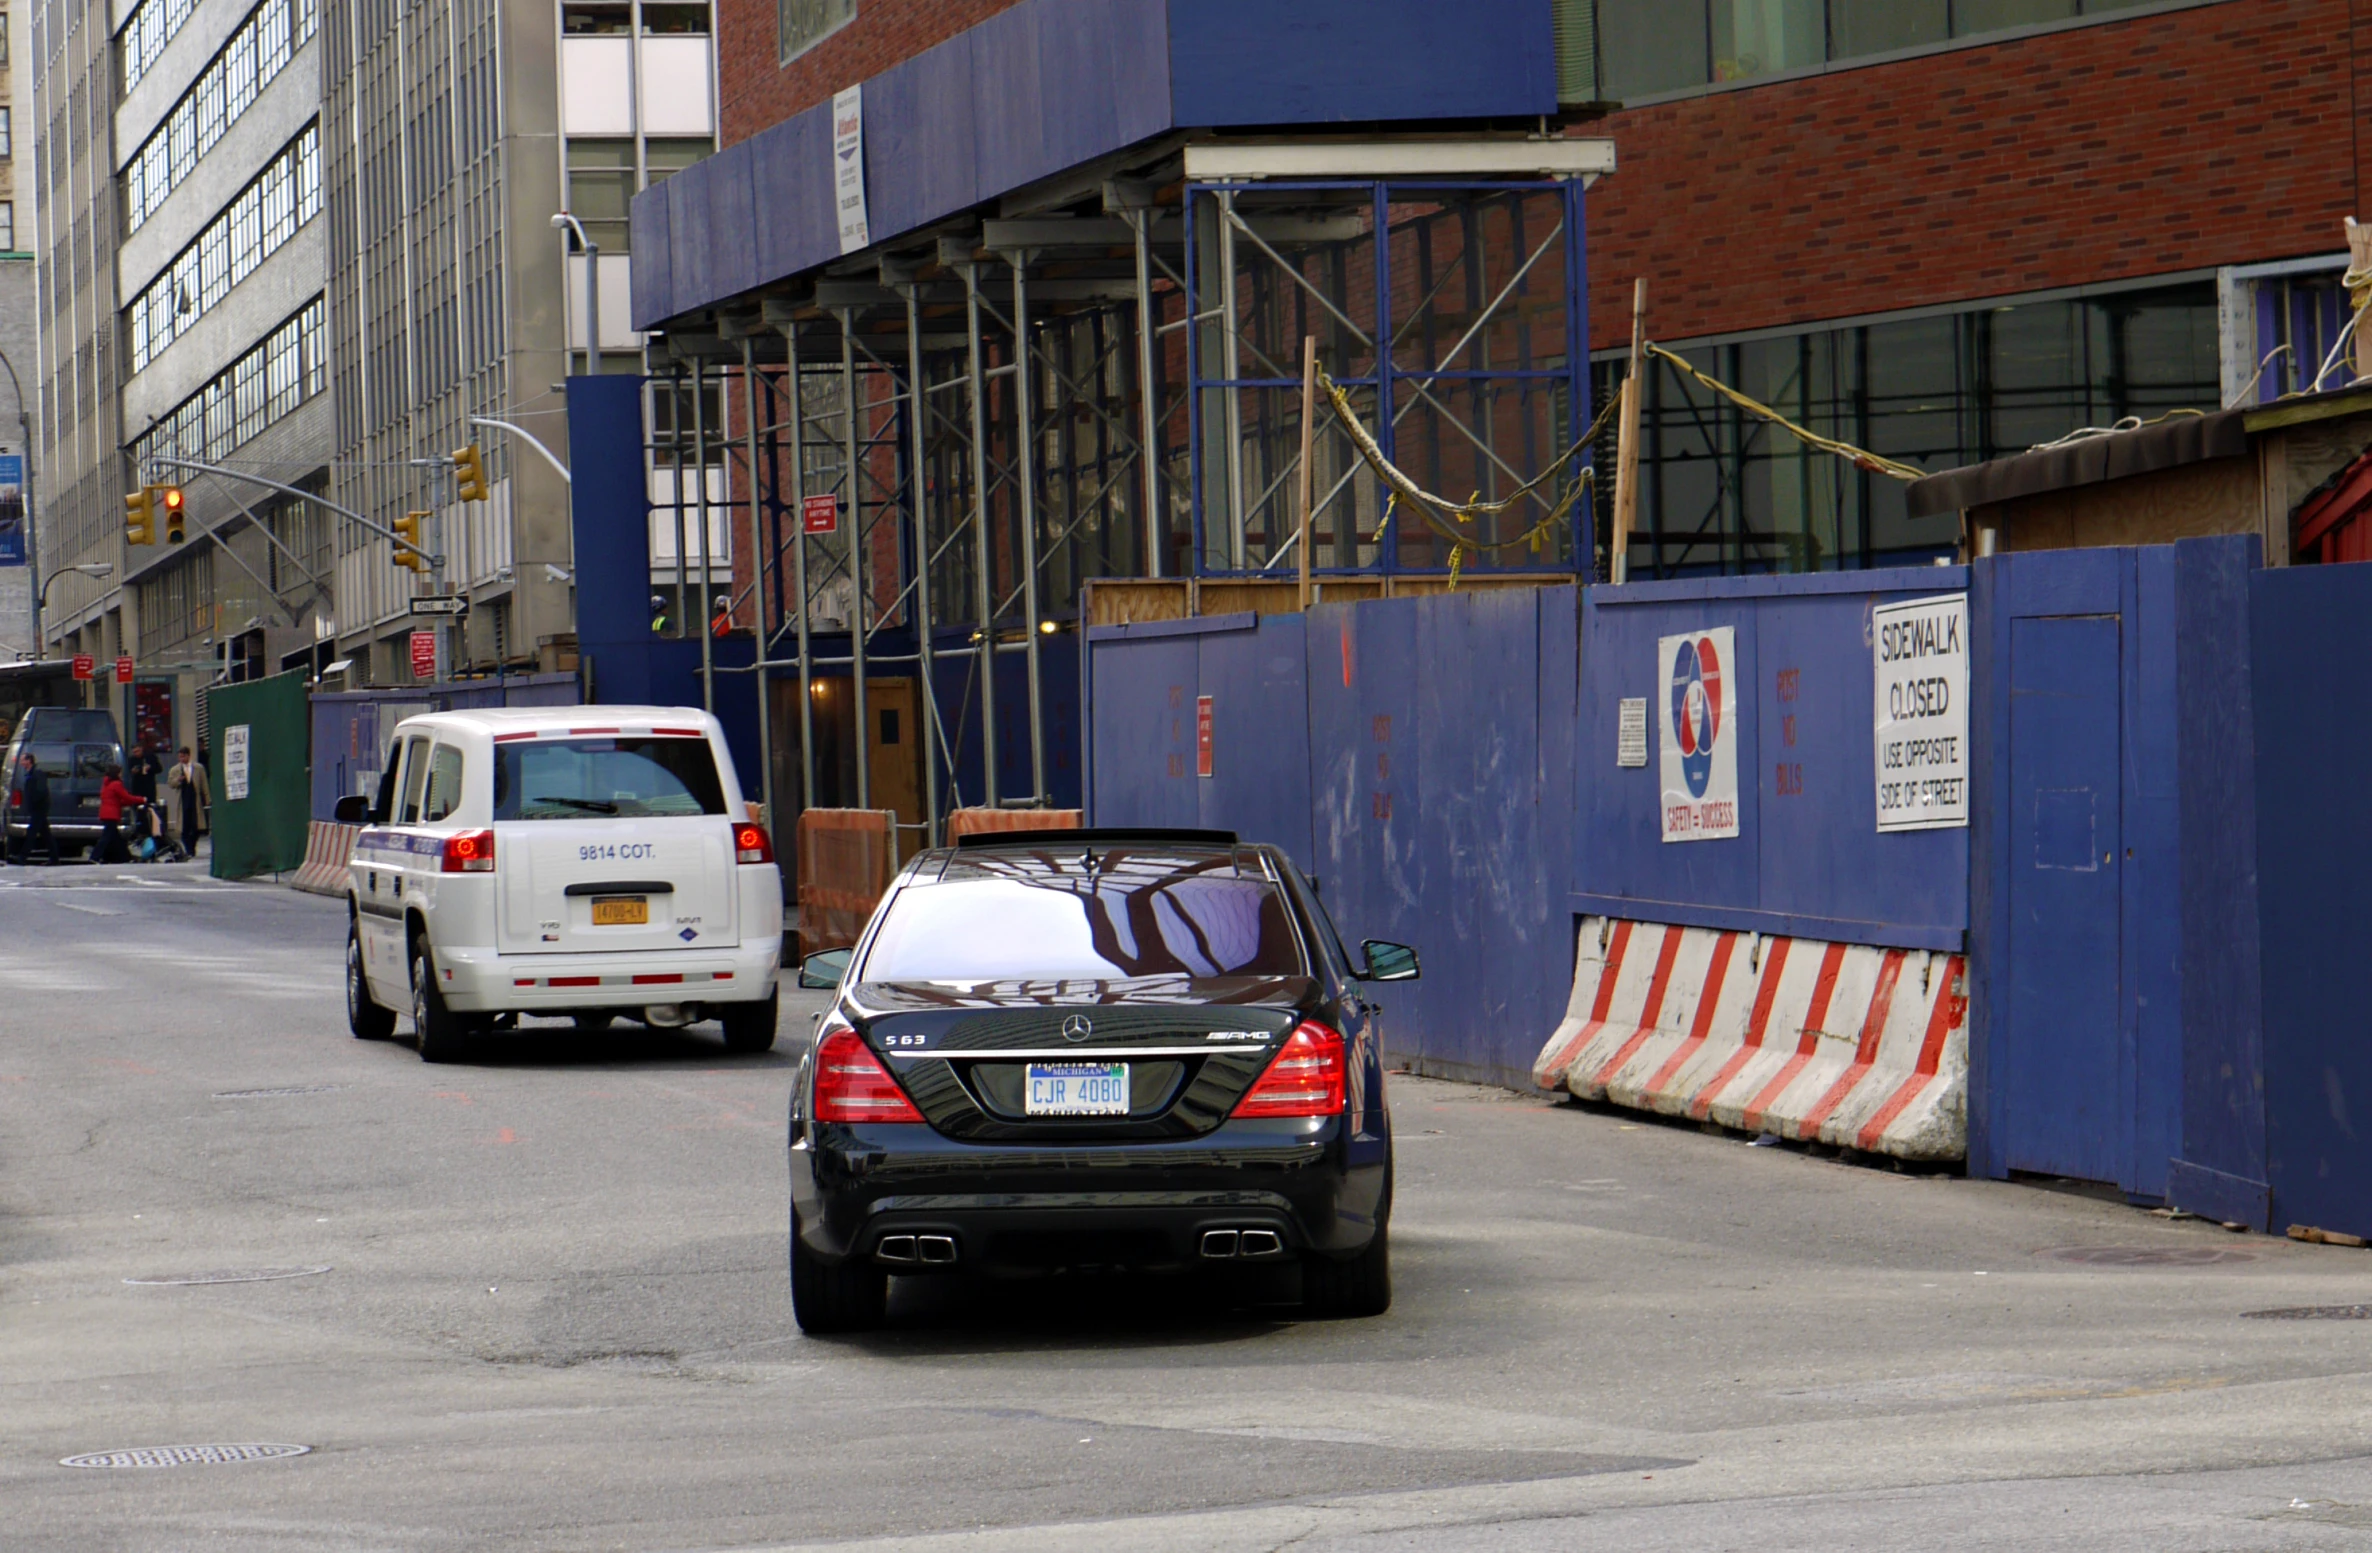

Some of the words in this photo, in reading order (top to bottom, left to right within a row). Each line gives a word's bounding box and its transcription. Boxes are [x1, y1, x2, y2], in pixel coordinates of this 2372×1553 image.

[417, 602, 435, 610] ONE
[443, 601, 461, 610] WAY
[1881, 613, 1960, 663] SIDEWALK
[1777, 668, 1800, 702] POST
[1890, 676, 1949, 720] CLOSED
[1783, 715, 1796, 747] NO
[1884, 741, 1902, 769] USE
[1905, 736, 1957, 767] OPPOSITE
[1776, 763, 1802, 796] BILLS
[1881, 781, 1902, 809] SIDE
[1904, 780, 1918, 807] OF
[1921, 777, 1963, 806] STREET
[1668, 804, 1692, 831] SAFETY
[1701, 801, 1734, 830] SUCCESS
[580, 845, 615, 860] 9814
[620, 844, 656, 859] COT.
[885, 1035, 896, 1046] S
[900, 1034, 925, 1045] 63
[1227, 1031, 1271, 1040] AMG
[1052, 1067, 1102, 1075] MICHIGAN
[1033, 1079, 1066, 1103] CJR
[1078, 1078, 1121, 1102] 4080
